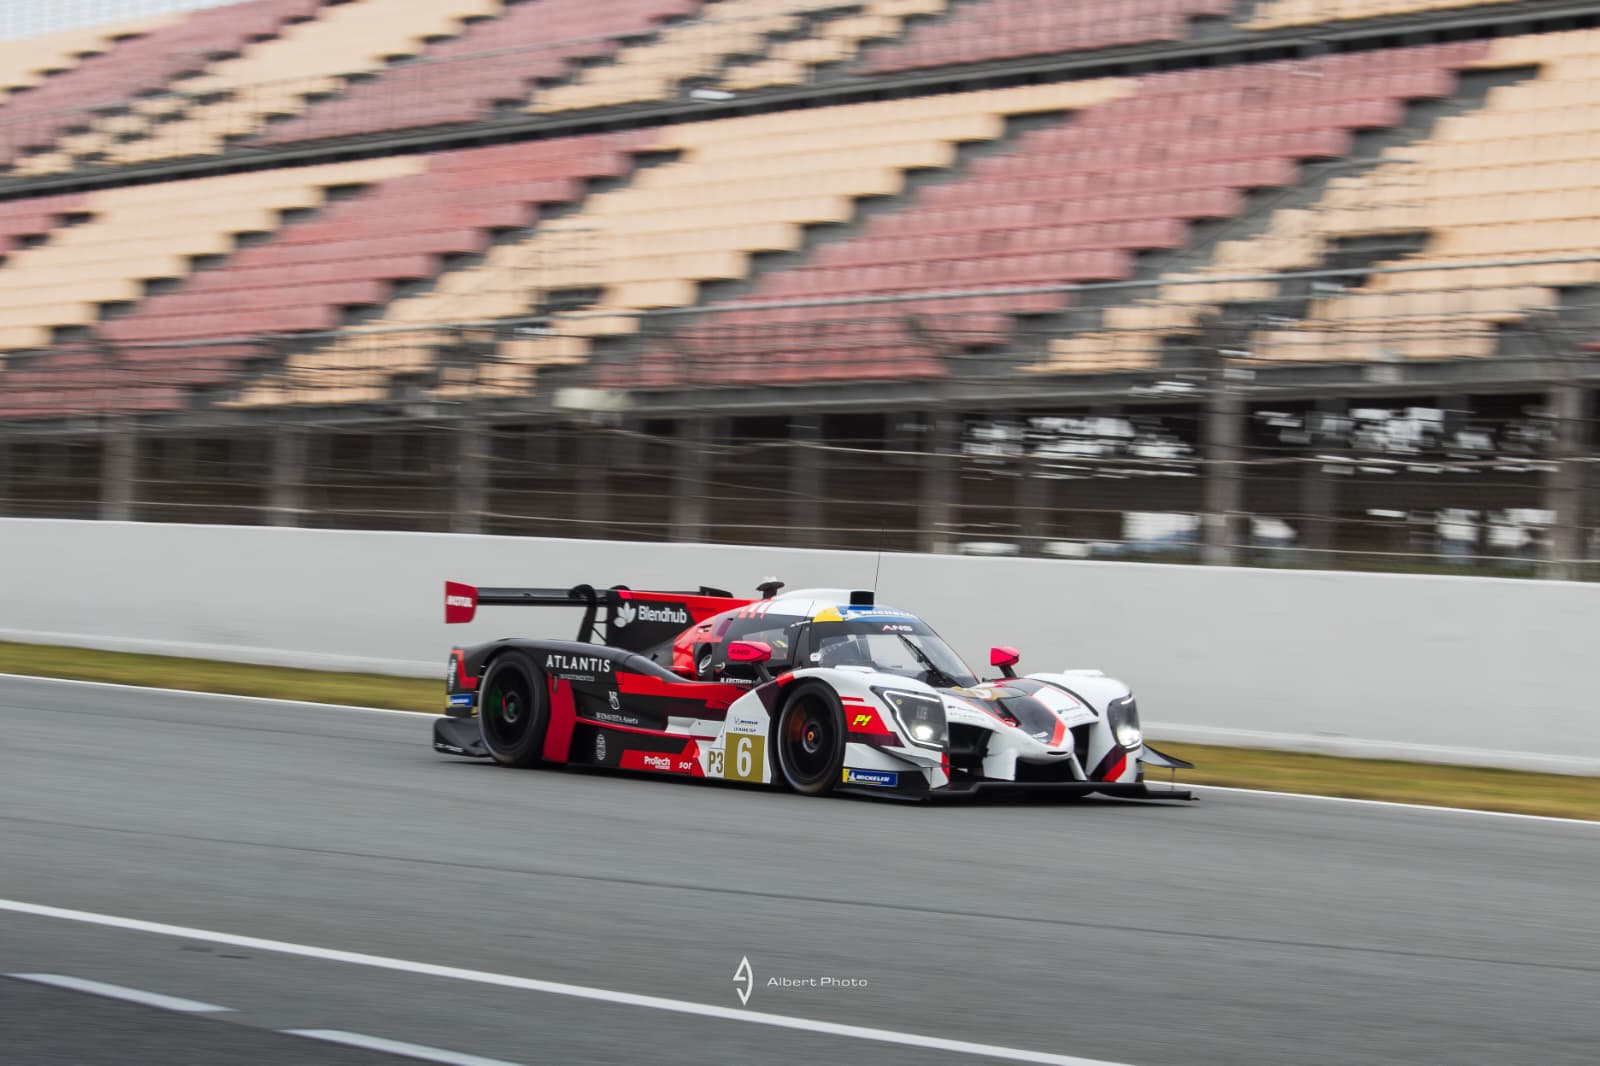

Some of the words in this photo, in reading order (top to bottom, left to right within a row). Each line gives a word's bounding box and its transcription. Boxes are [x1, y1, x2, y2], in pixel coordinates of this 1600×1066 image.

[638, 605, 687, 624] Blendhub
[882, 624, 913, 632] ANS
[545, 654, 611, 673] ATLANTIS
[644, 755, 671, 767] ProTech
[708, 751, 724, 774] P3
[736, 737, 752, 777] 6
[855, 774, 890, 782] MICHELIN
